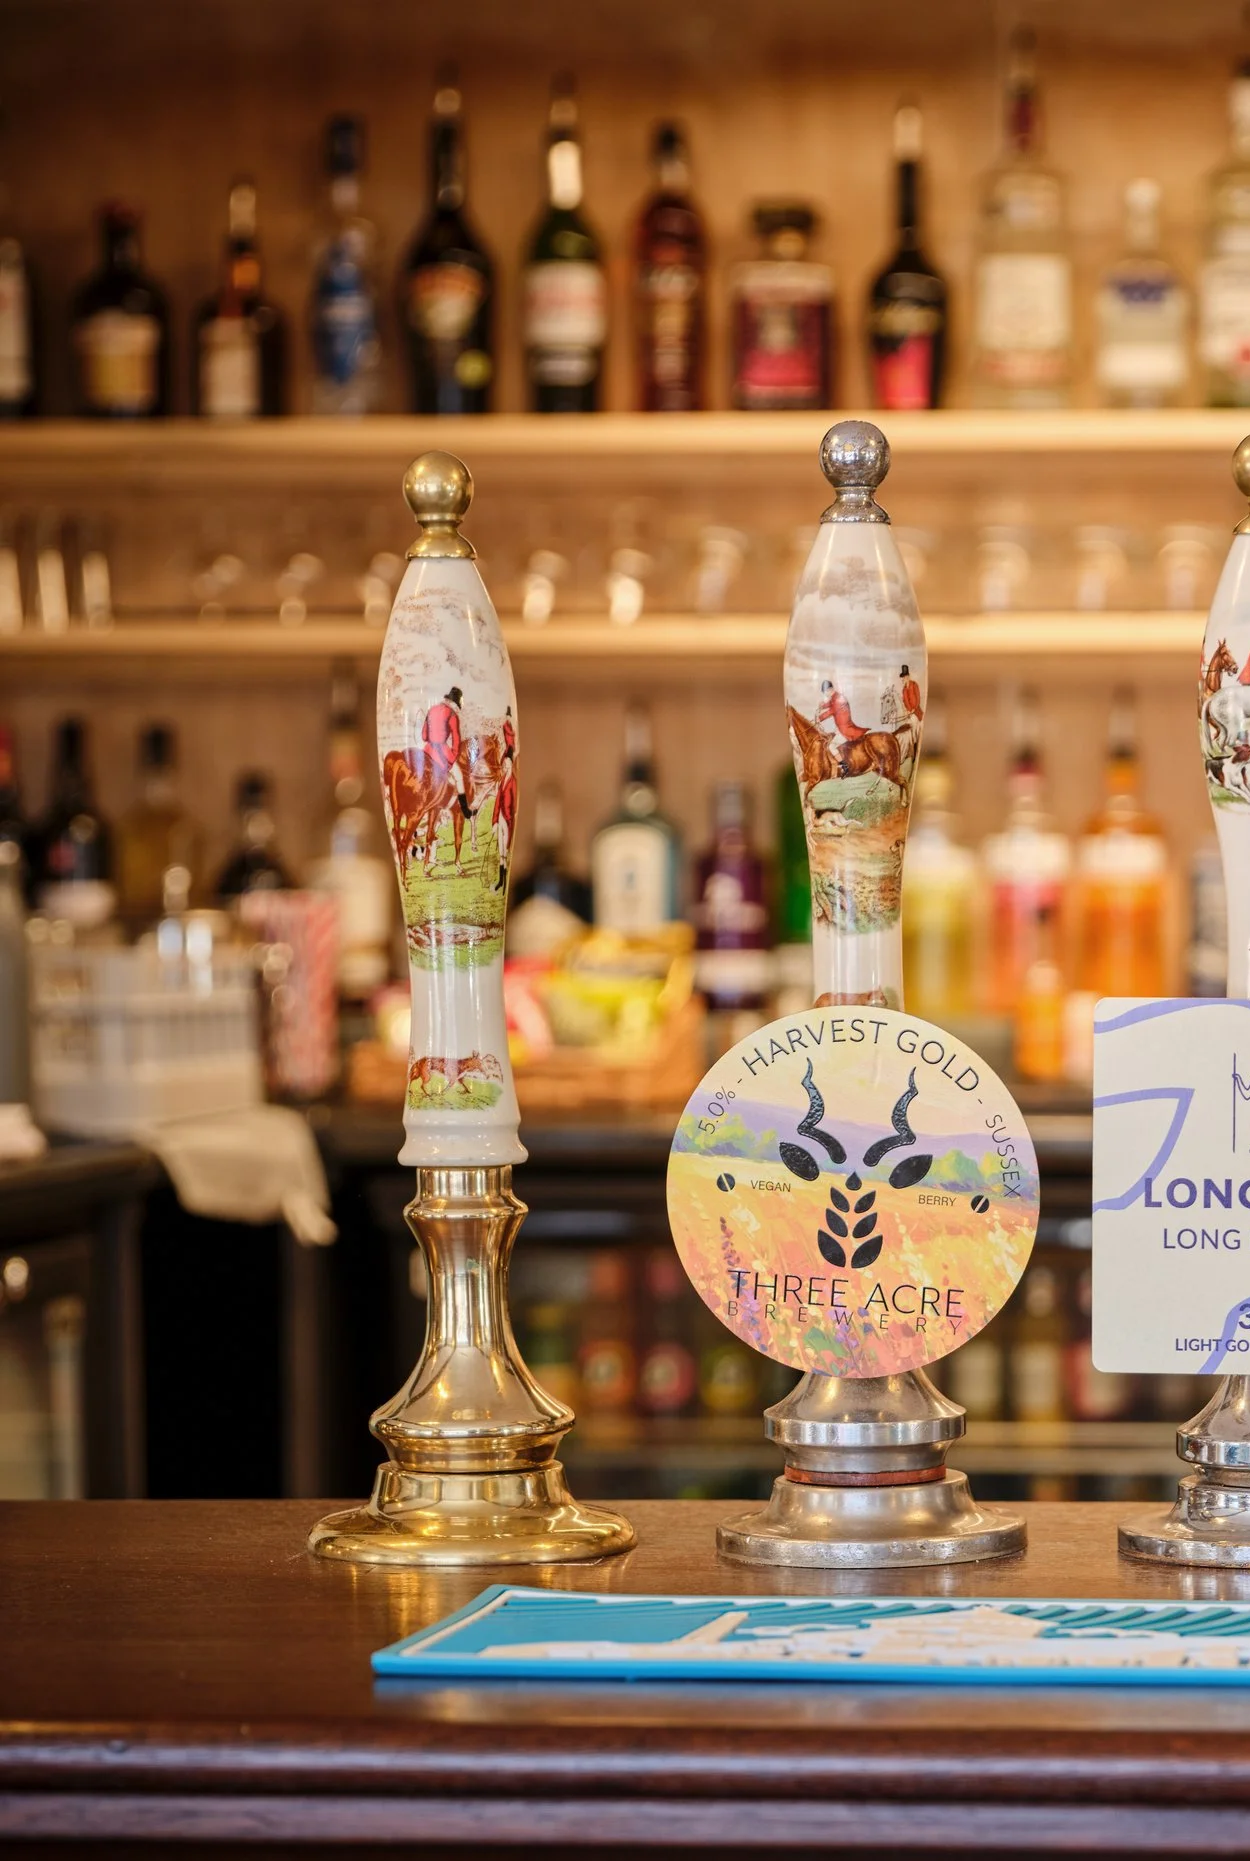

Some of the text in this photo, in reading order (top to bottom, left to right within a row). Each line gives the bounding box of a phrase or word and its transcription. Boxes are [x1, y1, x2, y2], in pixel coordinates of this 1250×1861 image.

[698, 1086, 736, 1135] 5.0%
[742, 1018, 888, 1076] HARVEST
[896, 1029, 980, 1091] GOLD
[985, 1114, 1021, 1198] SUSSEX
[750, 1180, 792, 1193] VEGAN
[918, 1193, 957, 1207] BERRY
[1163, 1228, 1242, 1250] LONG
[727, 1269, 965, 1319] THREE ACRE
[727, 1300, 962, 1336] BREWERY
[1175, 1338, 1222, 1352] LIGHT
